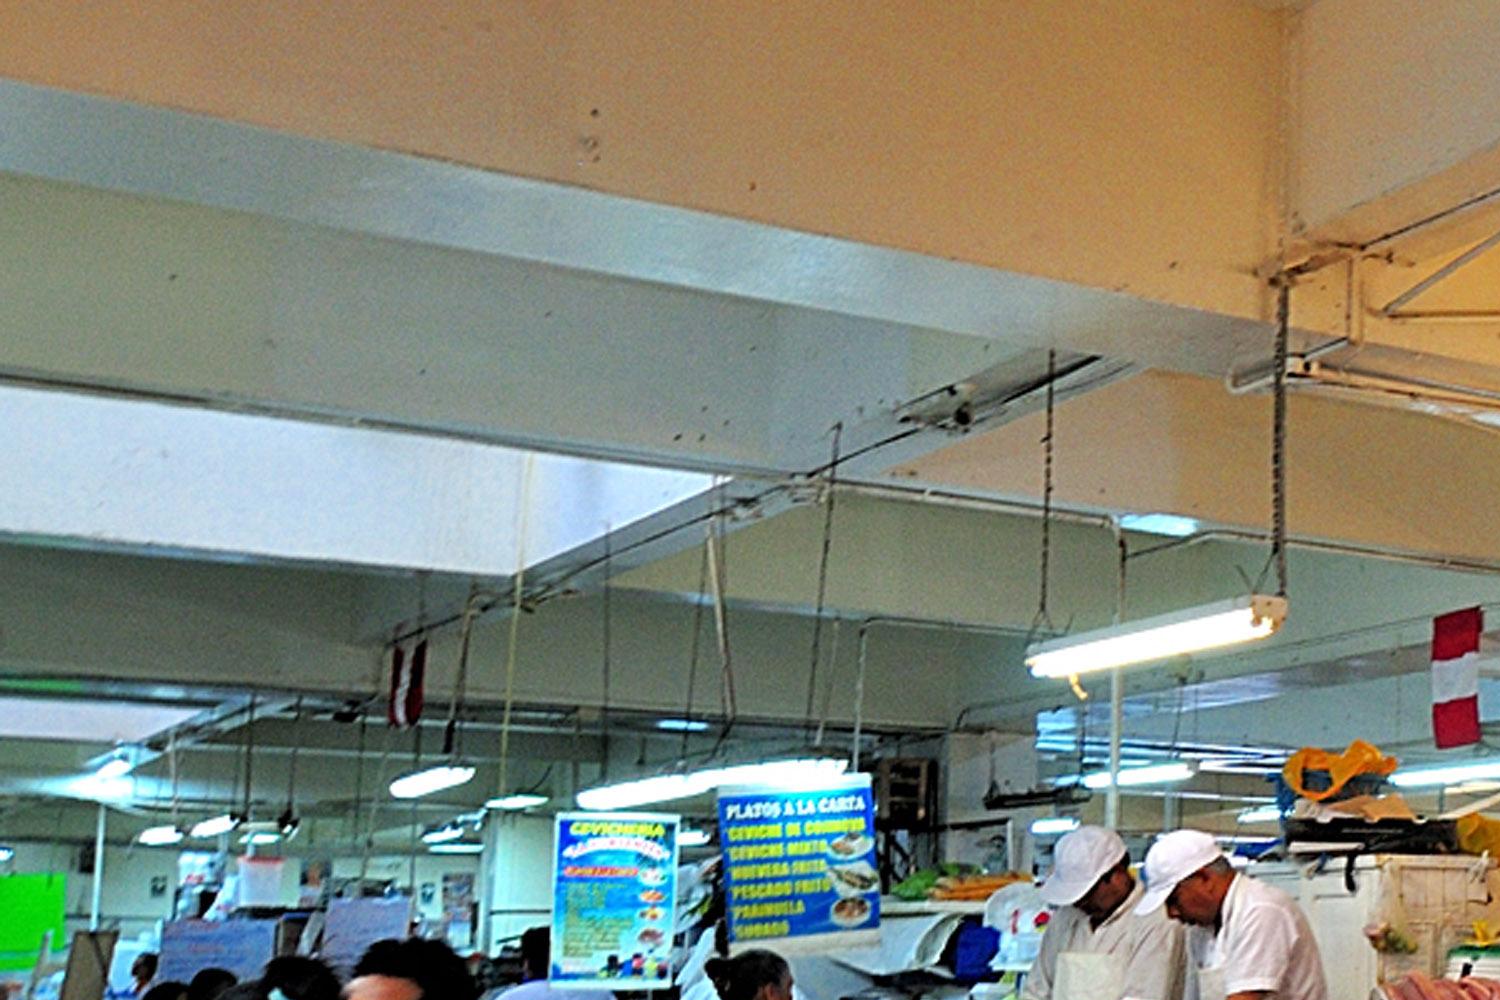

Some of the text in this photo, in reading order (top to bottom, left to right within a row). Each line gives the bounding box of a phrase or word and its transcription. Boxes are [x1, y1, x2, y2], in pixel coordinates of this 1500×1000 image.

[726, 795, 866, 821] PLATOS A LA CARTA
